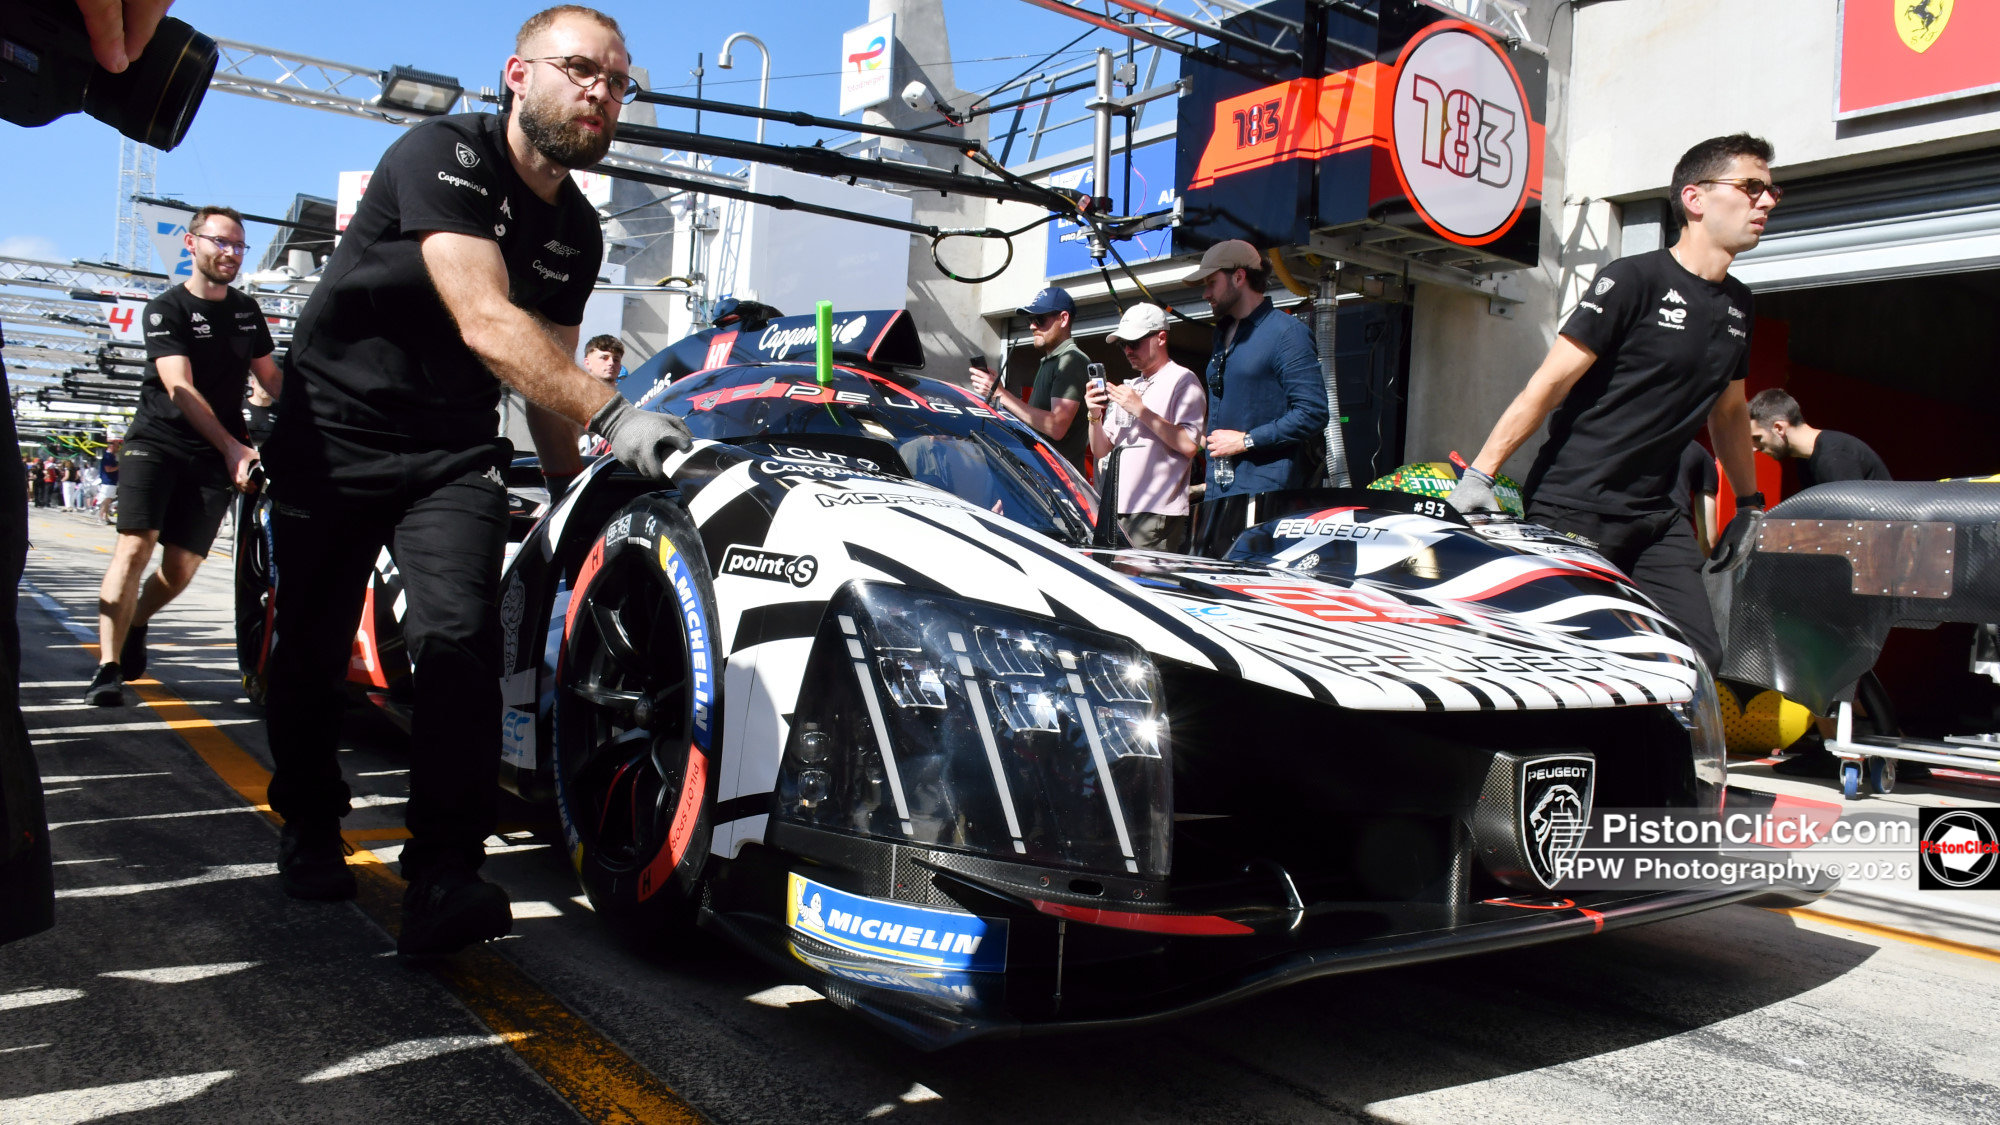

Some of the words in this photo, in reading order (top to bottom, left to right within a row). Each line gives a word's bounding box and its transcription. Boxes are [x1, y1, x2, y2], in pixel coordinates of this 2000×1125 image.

[1233, 97, 1283, 150] 183
[1413, 74, 1516, 189] 183
[109, 307, 134, 333] 4
[708, 342, 734, 370] HY
[785, 384, 1019, 422] PEUGEO
[786, 447, 847, 465] CUT
[1409, 477, 1457, 491] MILLE
[1413, 501, 1447, 518] #93
[1273, 518, 1389, 541] PEUGEOT
[728, 554, 786, 576] point
[676, 576, 708, 732] MICHELIN
[1321, 655, 1627, 673] PEUGEOT
[685, 762, 701, 812] PILOT
[1528, 767, 1588, 783] PEUGEOT
[671, 810, 689, 850] SPOR
[828, 909, 983, 954] MICHELIN
